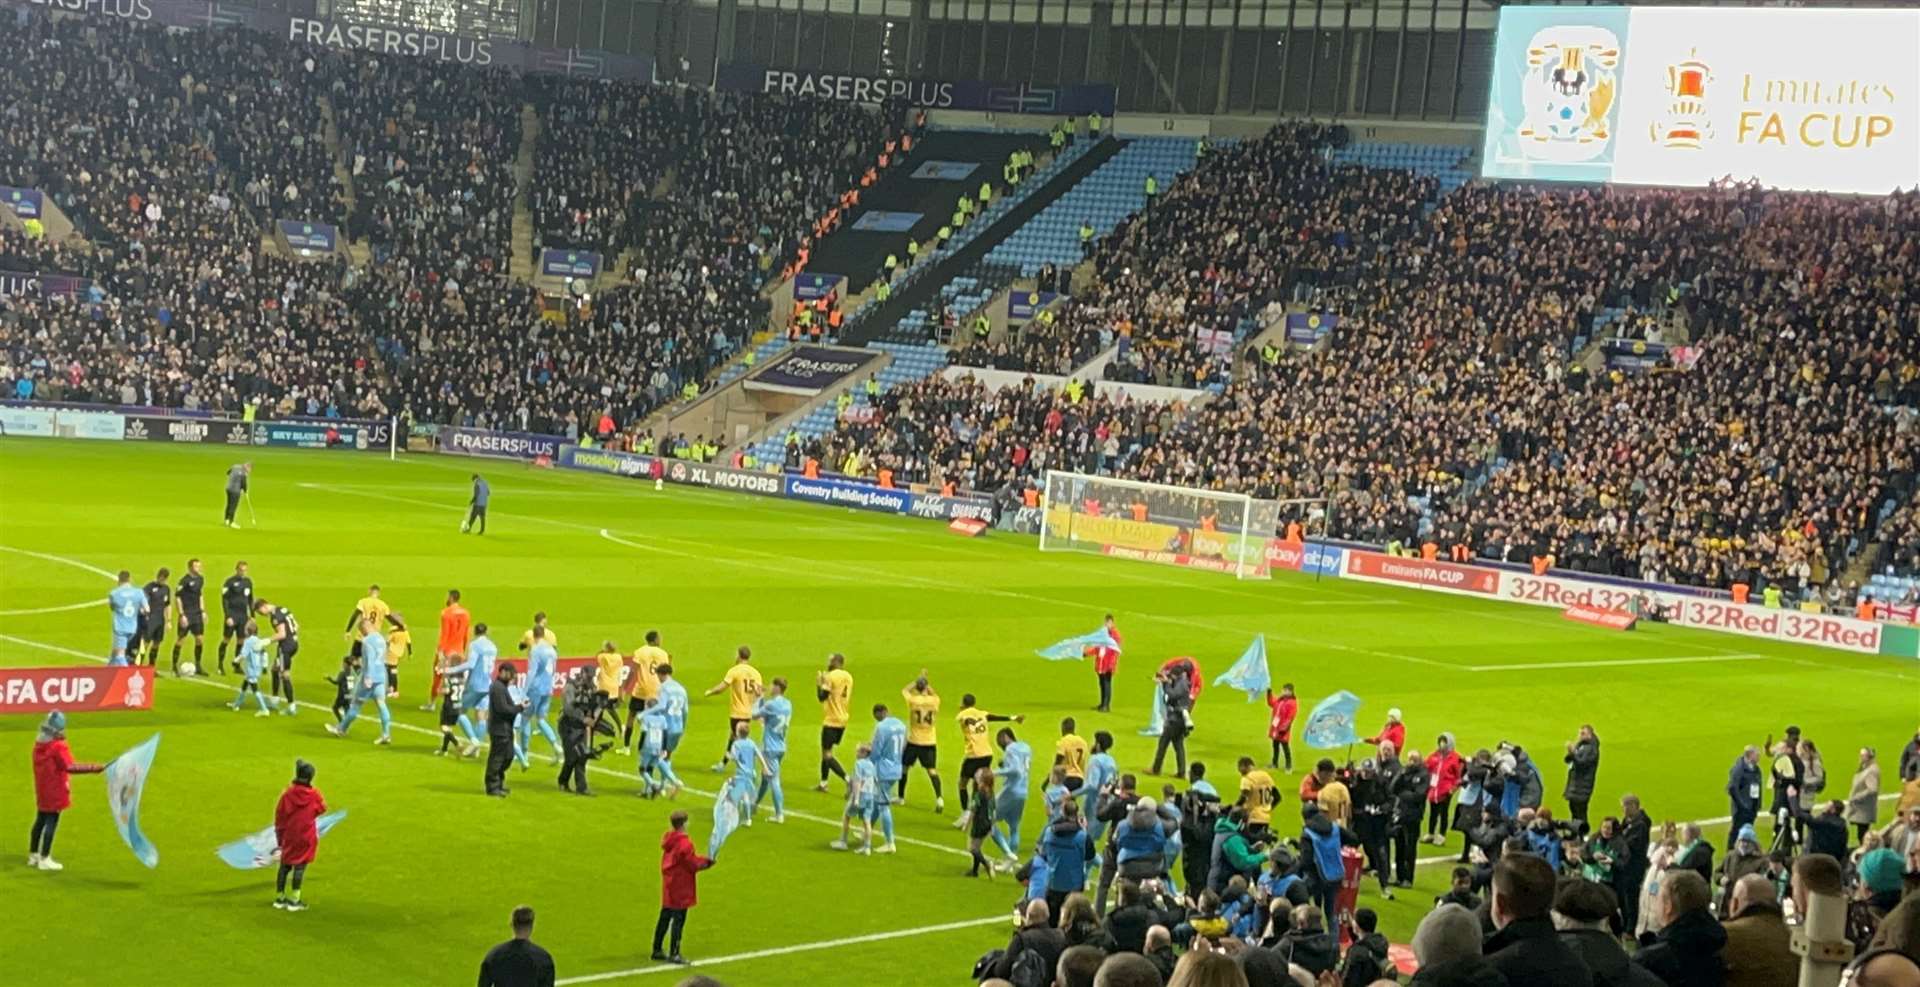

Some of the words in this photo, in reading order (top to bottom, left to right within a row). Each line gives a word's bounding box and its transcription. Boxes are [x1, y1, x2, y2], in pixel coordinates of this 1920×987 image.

[289, 17, 492, 65] FRASERSPLUS
[764, 70, 953, 107] FRASERSPLUS
[1738, 111, 1786, 145] FA
[1799, 113, 1894, 148] CUP
[453, 432, 554, 456] FRASERSPLUS
[691, 468, 711, 484] XL
[714, 471, 779, 493] MOTORS
[791, 480, 831, 500] Coventry
[832, 486, 869, 506] Building
[869, 492, 903, 510] Society
[1265, 545, 1302, 567] ebay
[1303, 551, 1341, 571] ebay
[1438, 570, 1464, 584] CUP
[1510, 577, 1594, 608] 32Red
[123, 603, 133, 617] 6
[369, 611, 377, 624] 8
[1689, 602, 1780, 635] 32Red
[1785, 615, 1879, 649] 32Red
[6, 678, 39, 705] FA
[41, 676, 96, 704] CUP
[743, 679, 755, 694] 15
[915, 710, 933, 725] 14
[1258, 787, 1273, 806] 10
